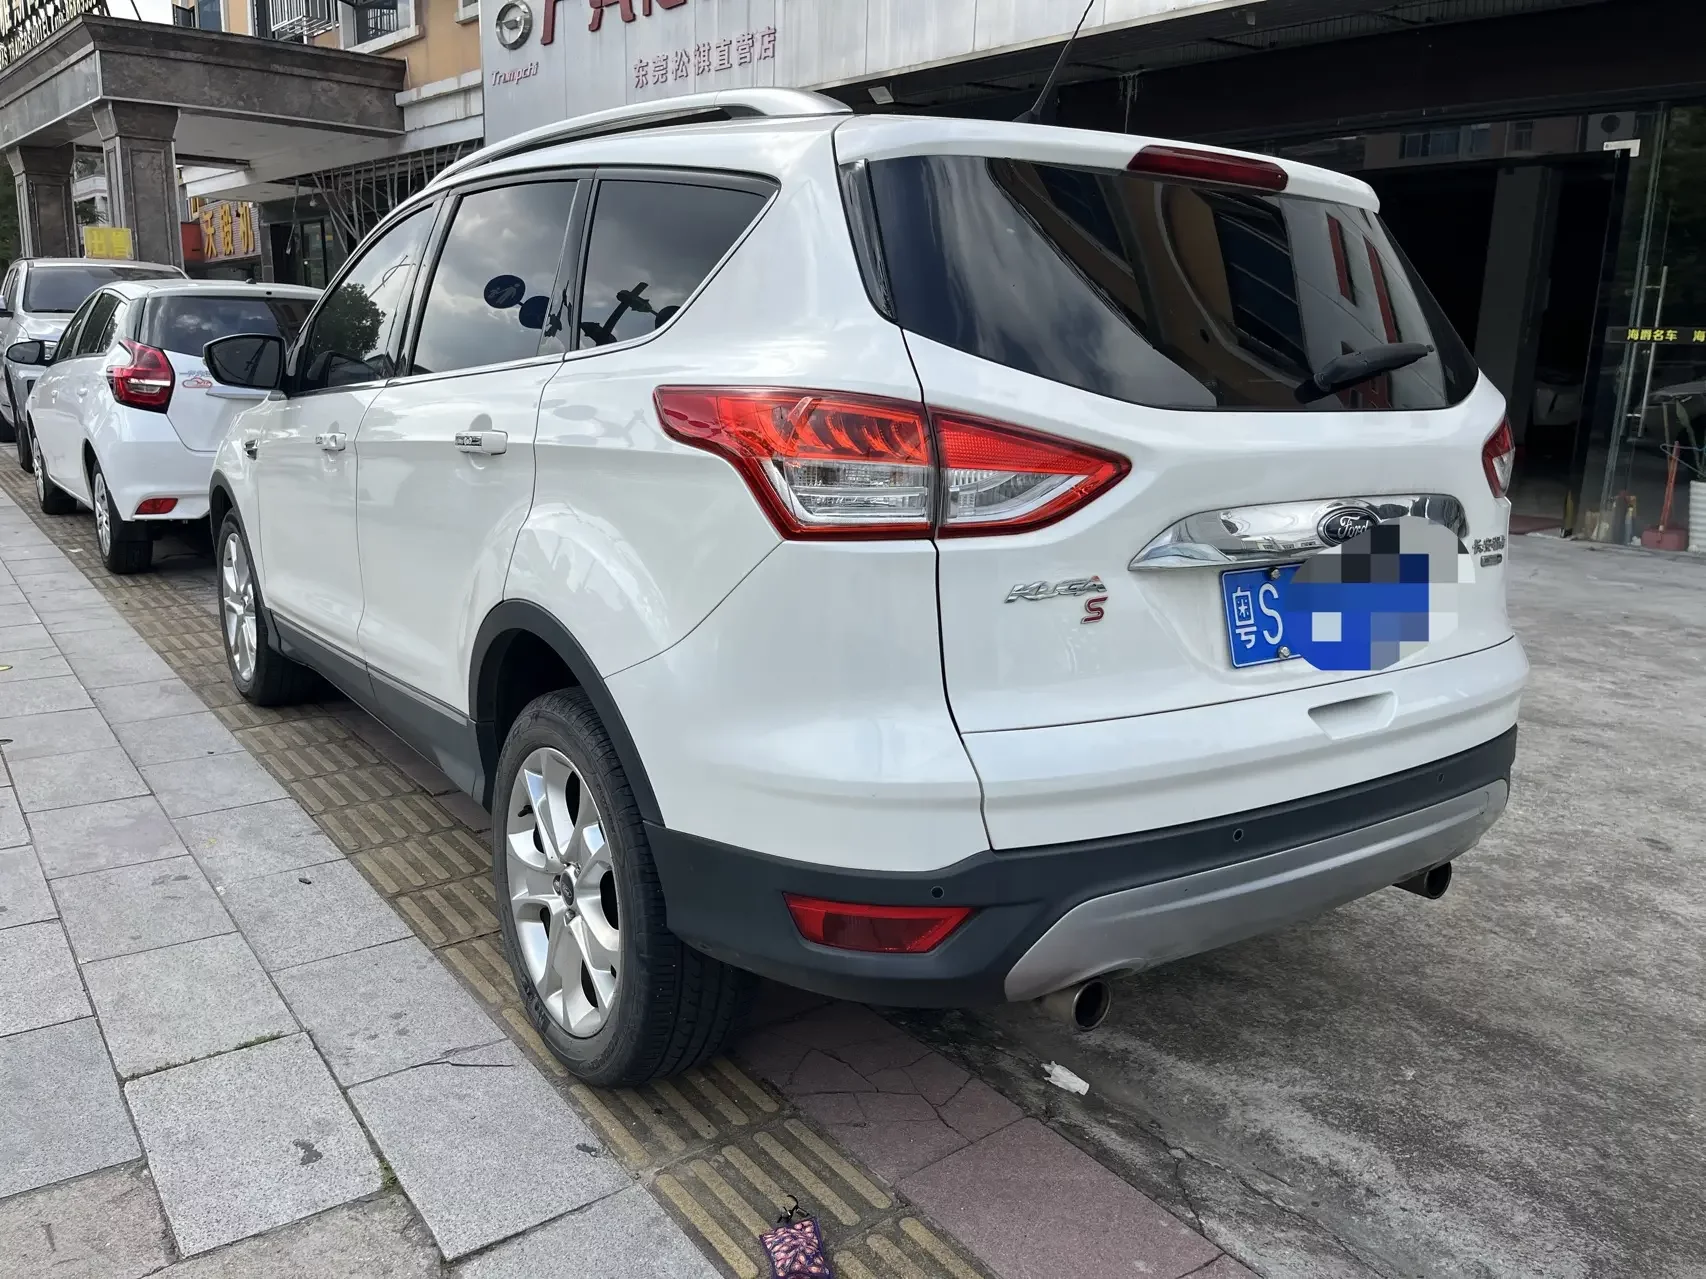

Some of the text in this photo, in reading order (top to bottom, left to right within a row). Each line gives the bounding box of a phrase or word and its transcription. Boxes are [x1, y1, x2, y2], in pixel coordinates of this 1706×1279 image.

[491, 61, 540, 87] Trumpchi
[1337, 515, 1369, 539] Ford
[1080, 596, 1109, 624] S
